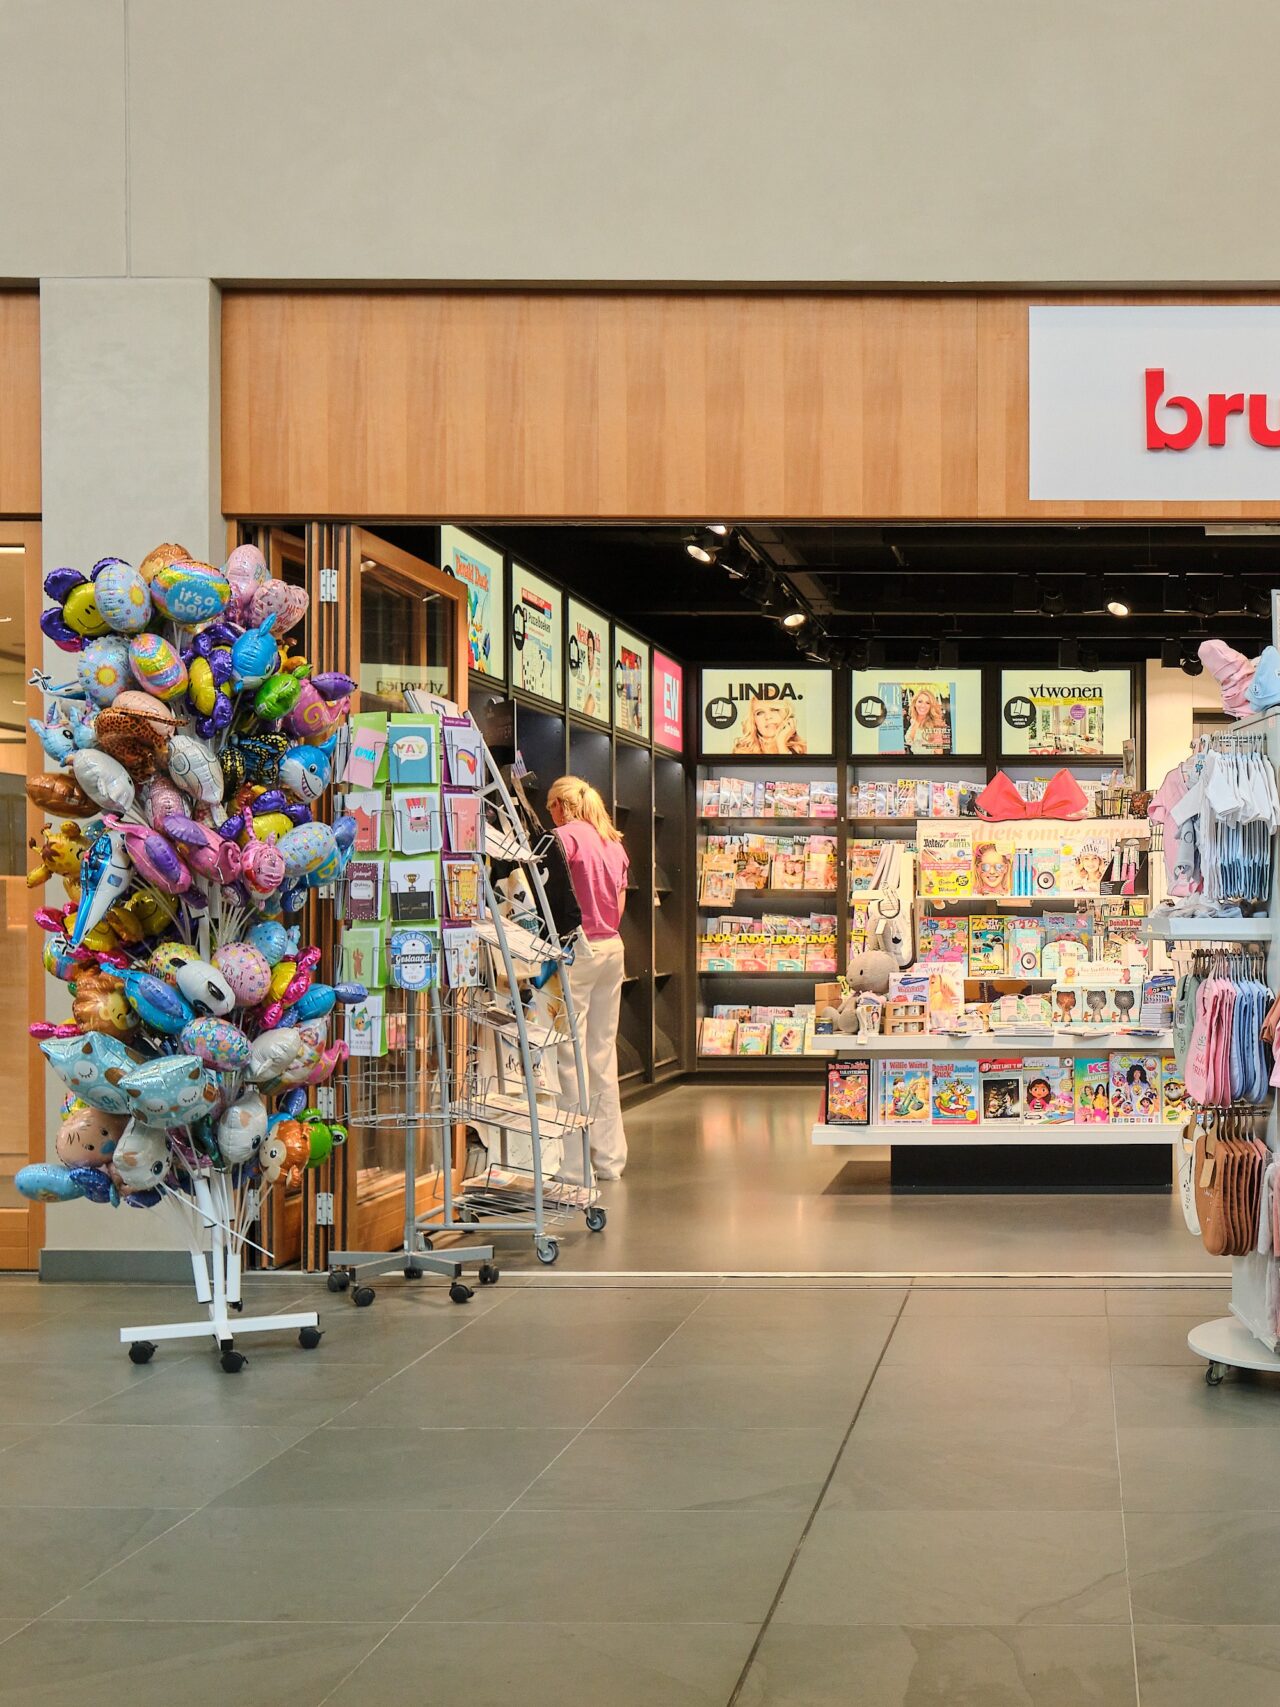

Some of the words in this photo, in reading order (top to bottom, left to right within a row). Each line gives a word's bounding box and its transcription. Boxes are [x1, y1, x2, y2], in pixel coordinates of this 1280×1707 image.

[728, 683, 804, 700] LINDA.
[1029, 684, 1103, 698] vtwonen
[954, 1064, 977, 1073] Junior
[1087, 1062, 1109, 1074] K3
